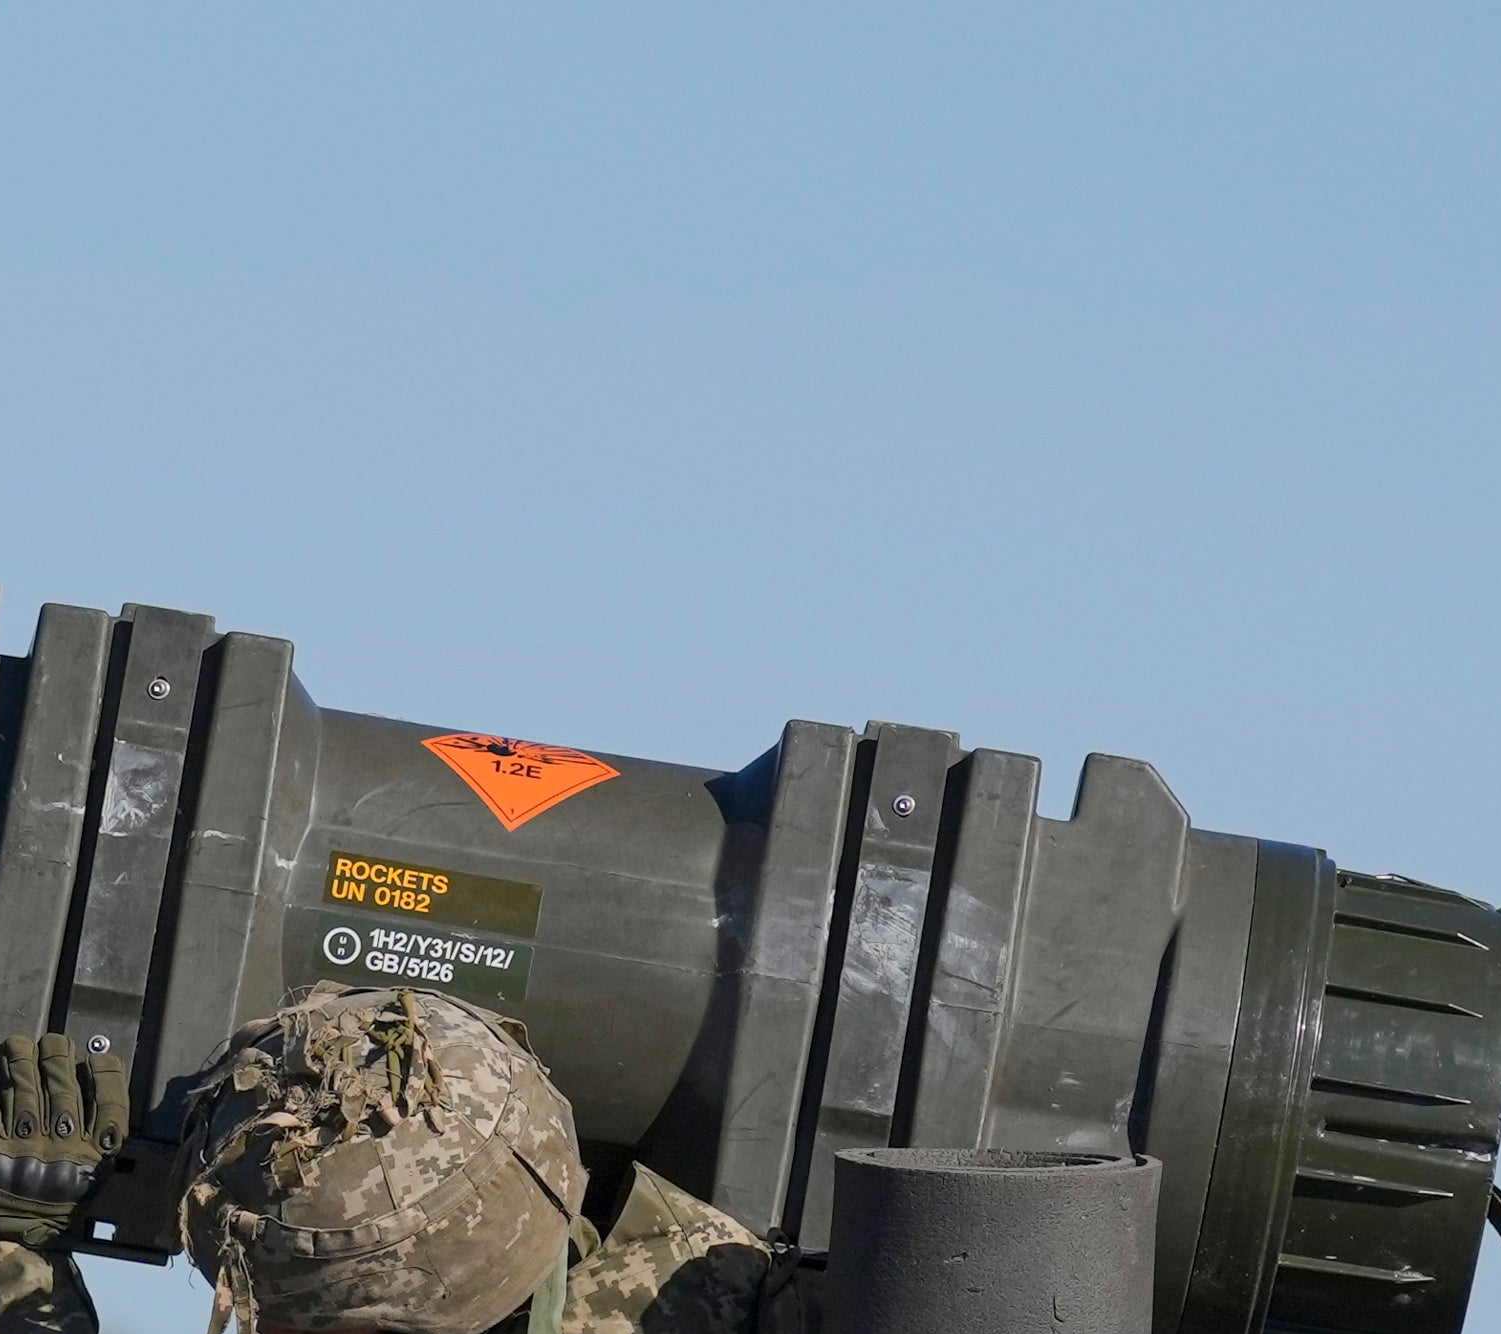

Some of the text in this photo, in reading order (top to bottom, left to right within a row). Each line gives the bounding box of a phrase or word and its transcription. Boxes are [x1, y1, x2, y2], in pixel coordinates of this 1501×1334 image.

[492, 760, 542, 779] 1.2E
[335, 858, 449, 894] ROCKETS
[331, 879, 431, 913] UN 0182
[368, 928, 515, 970] 1H2/Y31/S/12/
[365, 951, 454, 983] GB/5126
